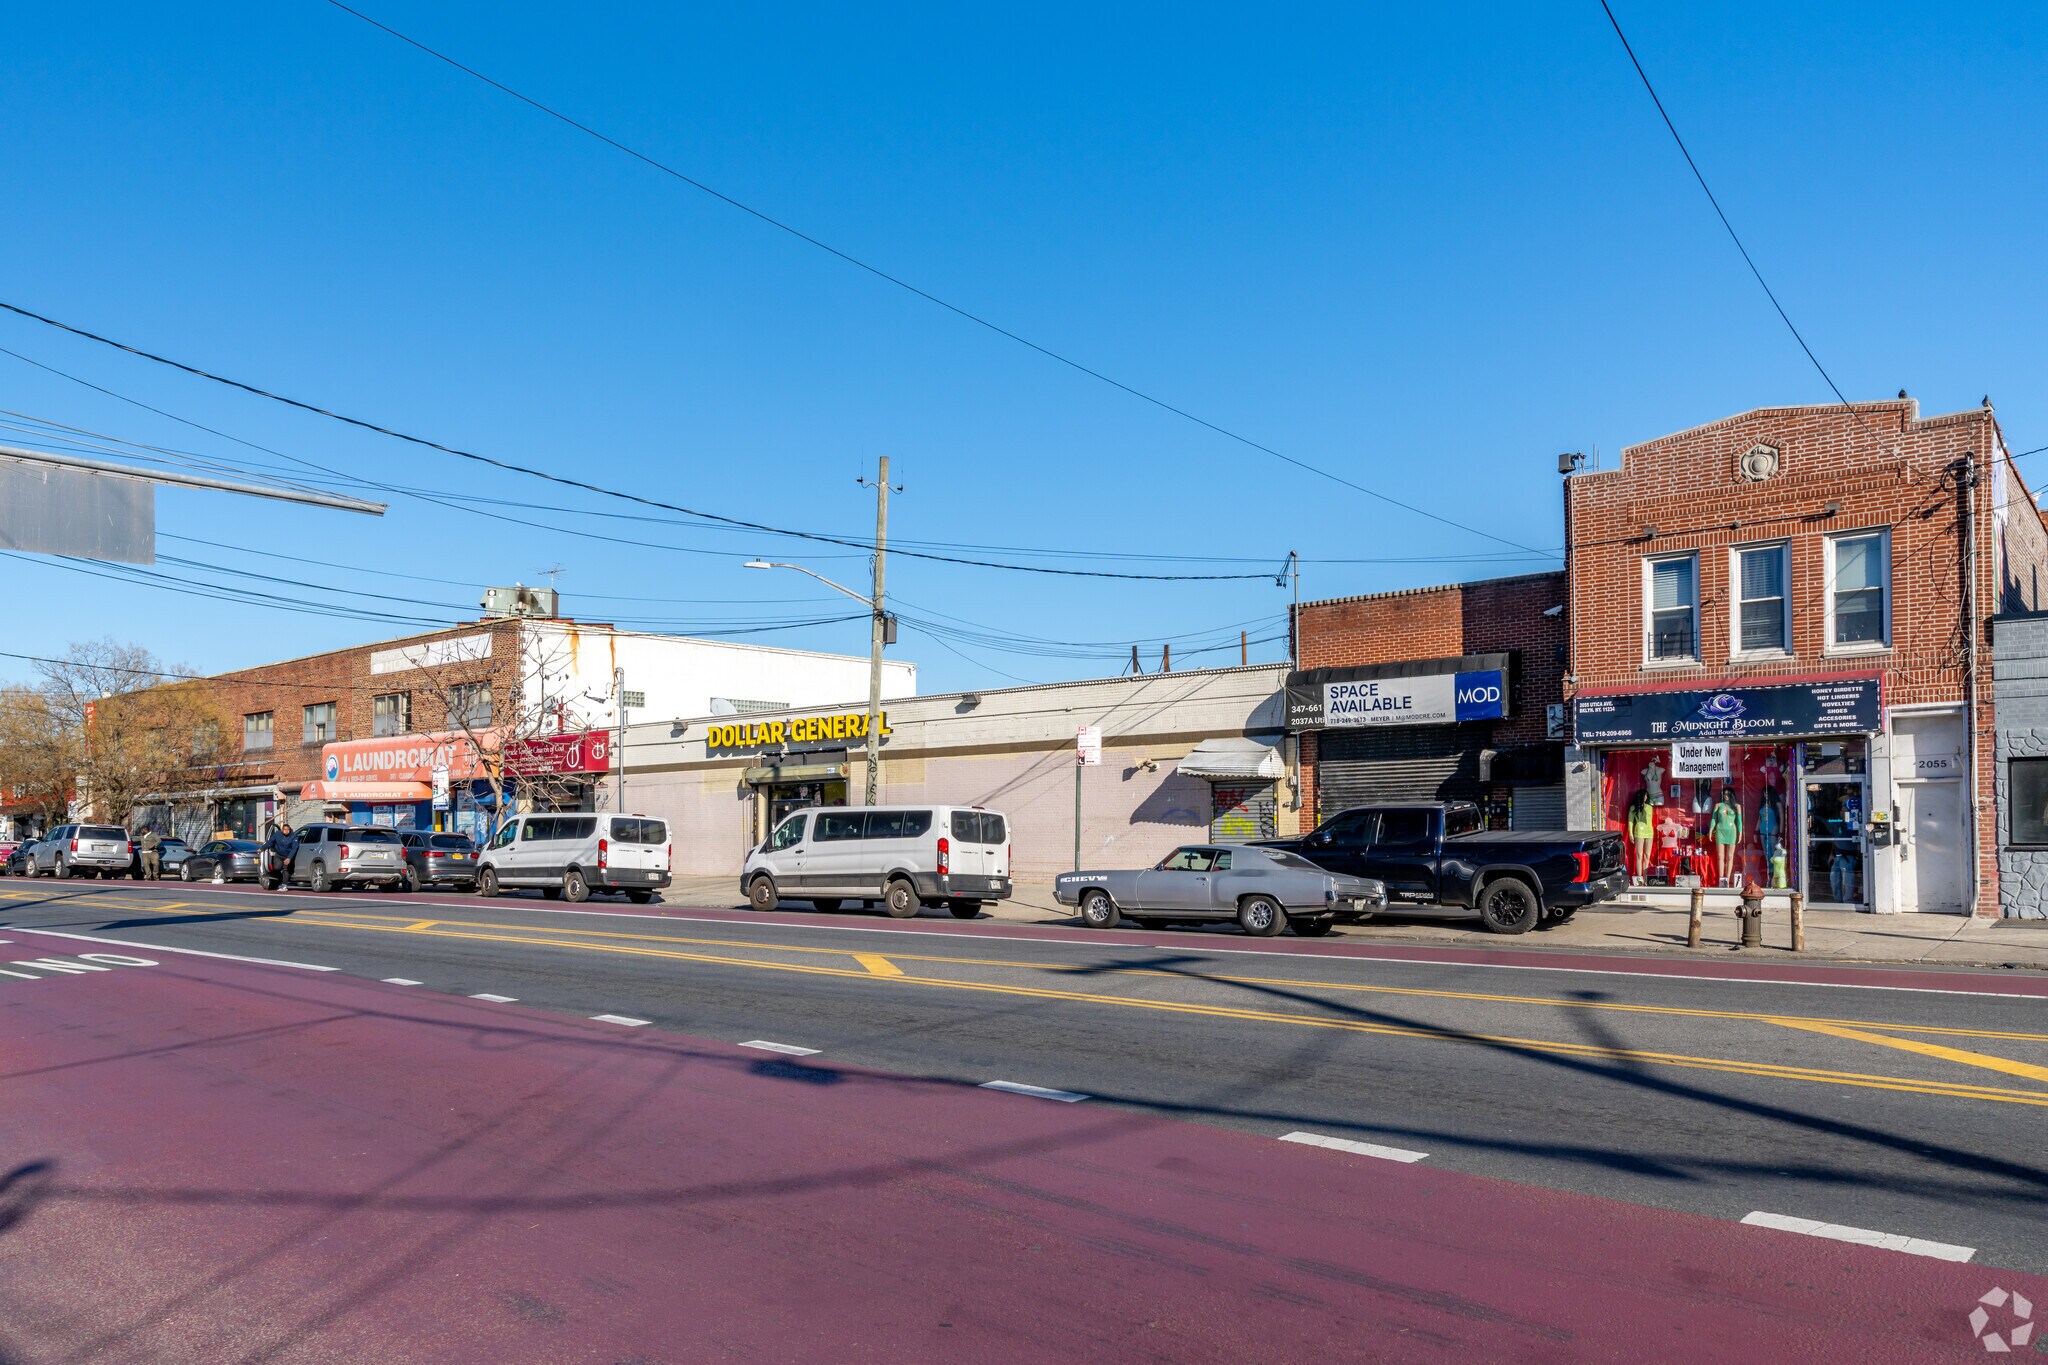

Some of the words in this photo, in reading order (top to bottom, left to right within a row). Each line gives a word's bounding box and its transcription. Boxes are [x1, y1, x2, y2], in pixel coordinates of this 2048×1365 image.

[1330, 684, 1378, 699] SPACE
[1458, 687, 1500, 704] MOD
[1330, 696, 1412, 714] AVAILABLE
[1291, 717, 1314, 726] 2037A
[1651, 722, 1668, 733] THE
[708, 721, 785, 748] DOLLAR
[1680, 746, 1703, 758] Under
[1704, 746, 1722, 757] New
[343, 745, 457, 773] LAUNDROMAT
[1918, 760, 1947, 769] 2055
[1679, 761, 1725, 774] Management
[1062, 875, 1106, 883] CHEVY
